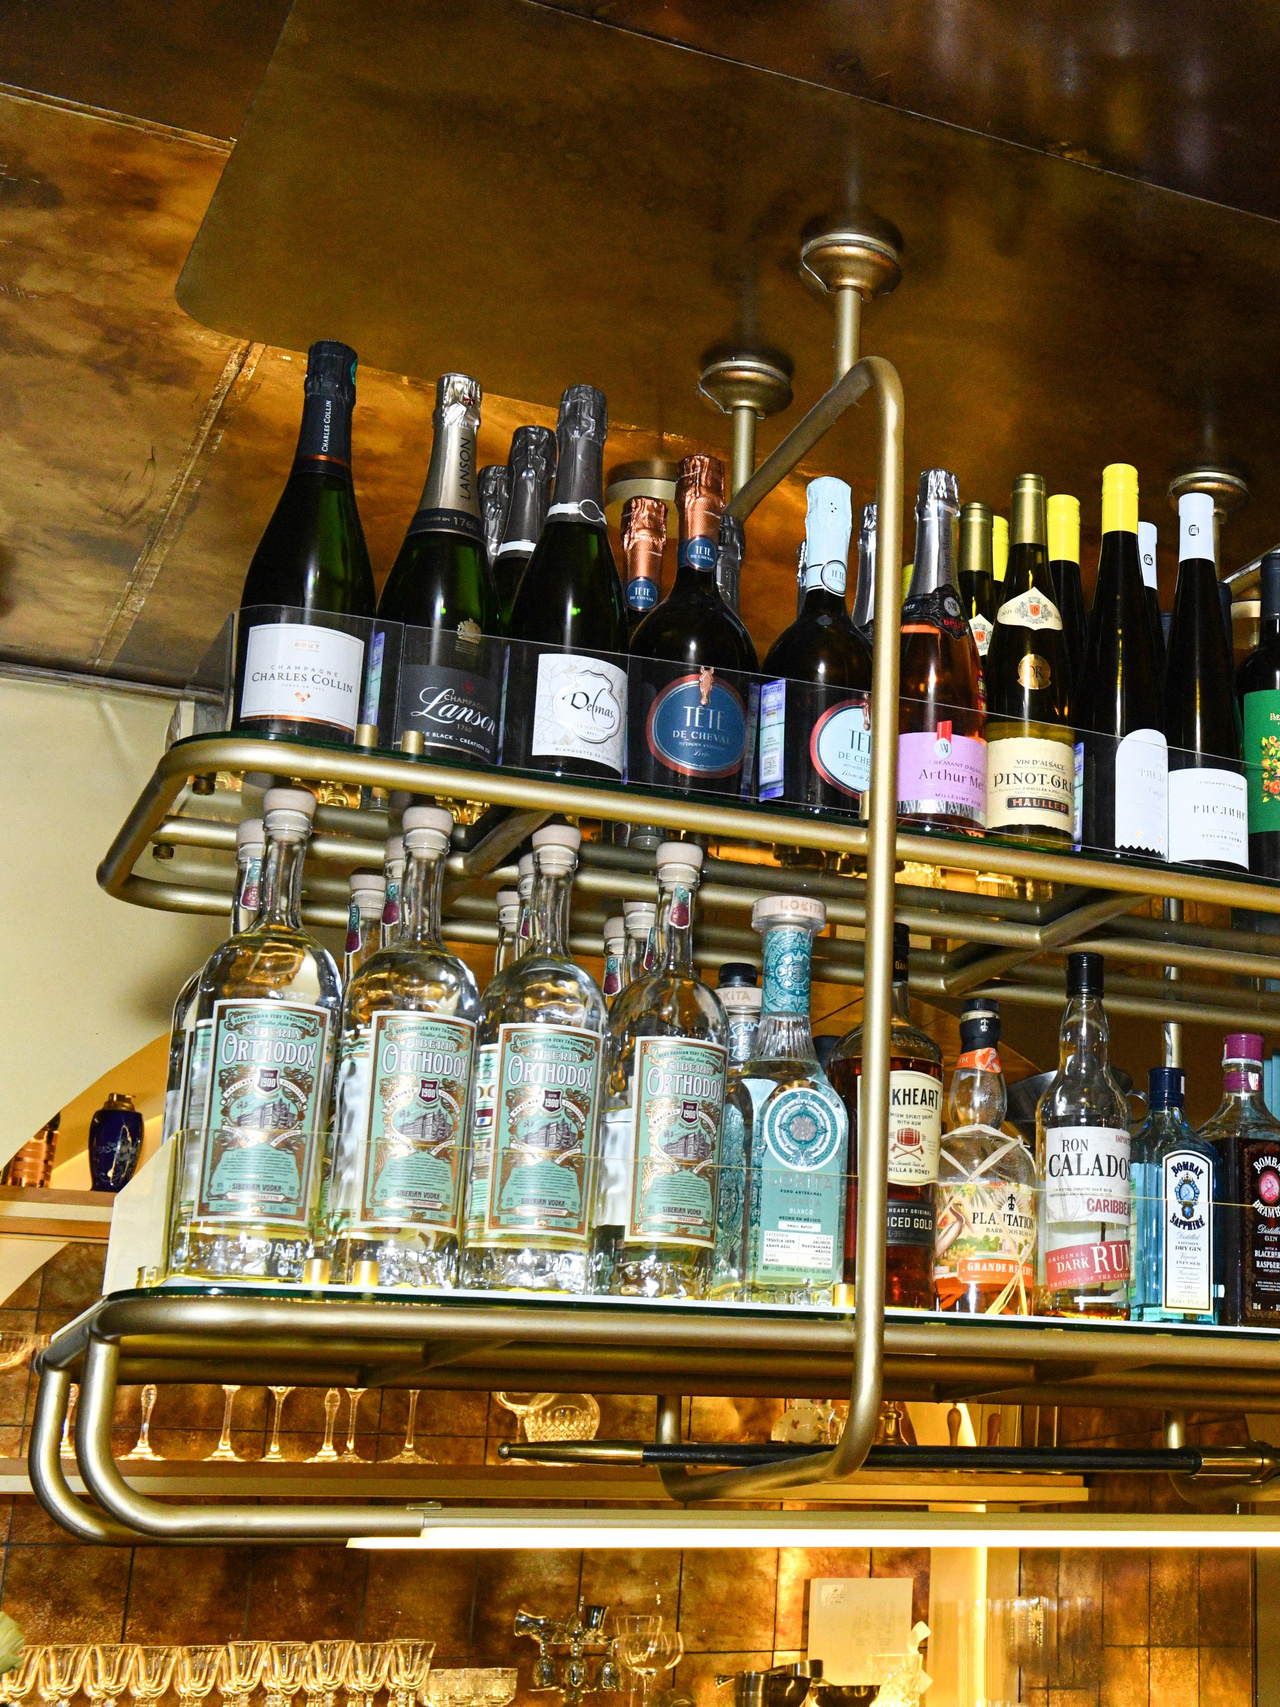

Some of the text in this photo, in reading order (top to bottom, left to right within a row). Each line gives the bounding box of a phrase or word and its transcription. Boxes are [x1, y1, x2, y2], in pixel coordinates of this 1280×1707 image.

[321, 400, 332, 452] CHARLES COLLIN
[459, 437, 472, 500] LANSON
[943, 619, 964, 629] BRUT
[270, 664, 339, 678] CHAMPAGNE
[252, 672, 307, 682] CHARLES
[311, 674, 353, 693] COLLIN
[411, 686, 496, 736] Lanson
[432, 732, 454, 741] BLACK
[672, 730, 687, 739] DE
[848, 728, 871, 754] TÊT
[838, 751, 851, 760] DE
[1032, 760, 1065, 771] D'ALSACE
[919, 769, 967, 783] Arthur
[1012, 798, 1066, 812] HAULLER
[243, 1026, 301, 1040] SIBERIA
[221, 1032, 317, 1072] ORTHODOX
[406, 1038, 457, 1053] SIBERIA
[382, 1043, 468, 1083] ORTHODOX
[529, 1049, 581, 1063] SIBERIA
[508, 1055, 593, 1094] ORTHODOX
[668, 1061, 714, 1076] SIBERIA
[260, 1078, 275, 1087] 1900
[646, 1066, 722, 1105] ORTHODOX
[421, 1088, 436, 1098] 1900
[891, 1088, 939, 1110] KHEART
[544, 1098, 559, 1108] 1900
[683, 1109, 696, 1119] 1900
[1061, 1139, 1089, 1153] RON
[914, 1168, 930, 1176] HONEY
[1170, 1161, 1204, 1179] BOMBAY
[232, 1183, 282, 1192] SIBERIAN VODKA
[396, 1190, 440, 1200] SIBERIAN VODKA
[520, 1197, 565, 1207] SIBERIAN VODKA
[662, 1206, 702, 1216] SIBERIAN VODKA
[1087, 1198, 1130, 1216] CARIBBEA
[887, 1217, 933, 1231] ICED GOLD
[1169, 1212, 1206, 1230] SAPPHIRE
[1048, 1251, 1085, 1263] ORIGINAL
[967, 1262, 1007, 1273] GRANDE
[1056, 1257, 1090, 1273] DARK
[1050, 1277, 1082, 1288] PRODUCT
